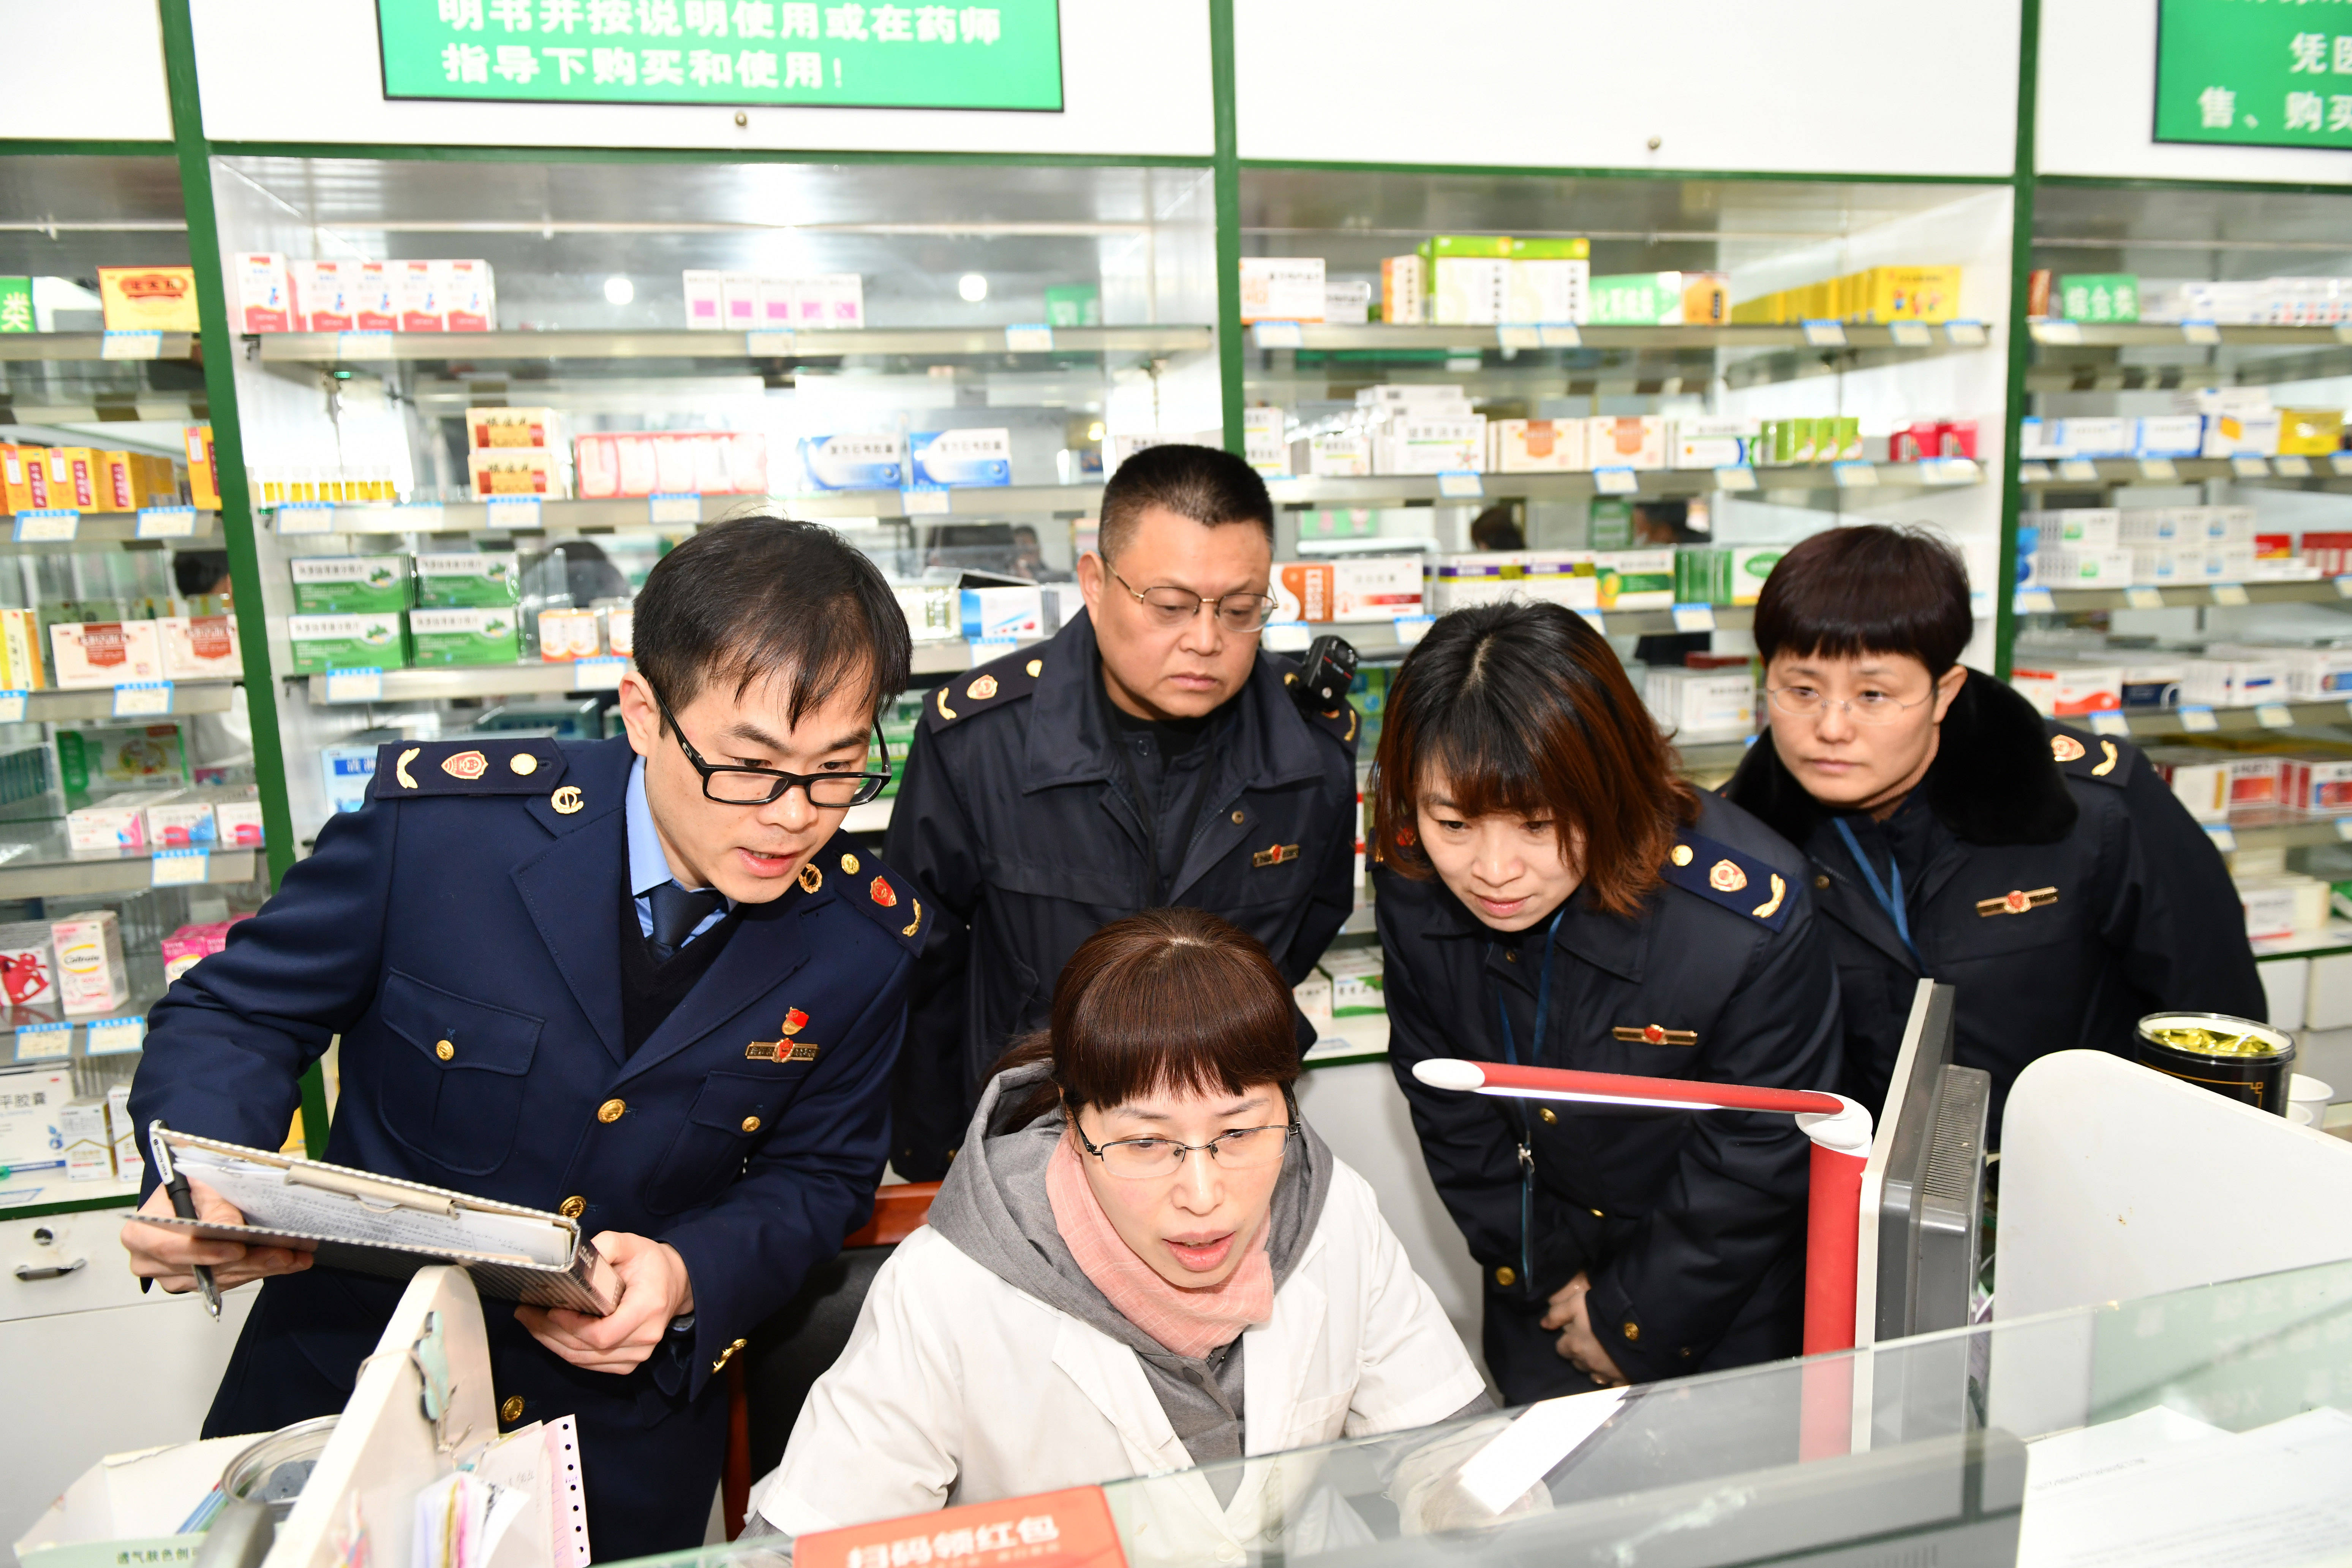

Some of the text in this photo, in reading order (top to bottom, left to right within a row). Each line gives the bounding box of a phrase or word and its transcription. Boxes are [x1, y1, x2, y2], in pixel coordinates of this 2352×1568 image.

[846, 1514, 1060, 1568] 扫码领红包
